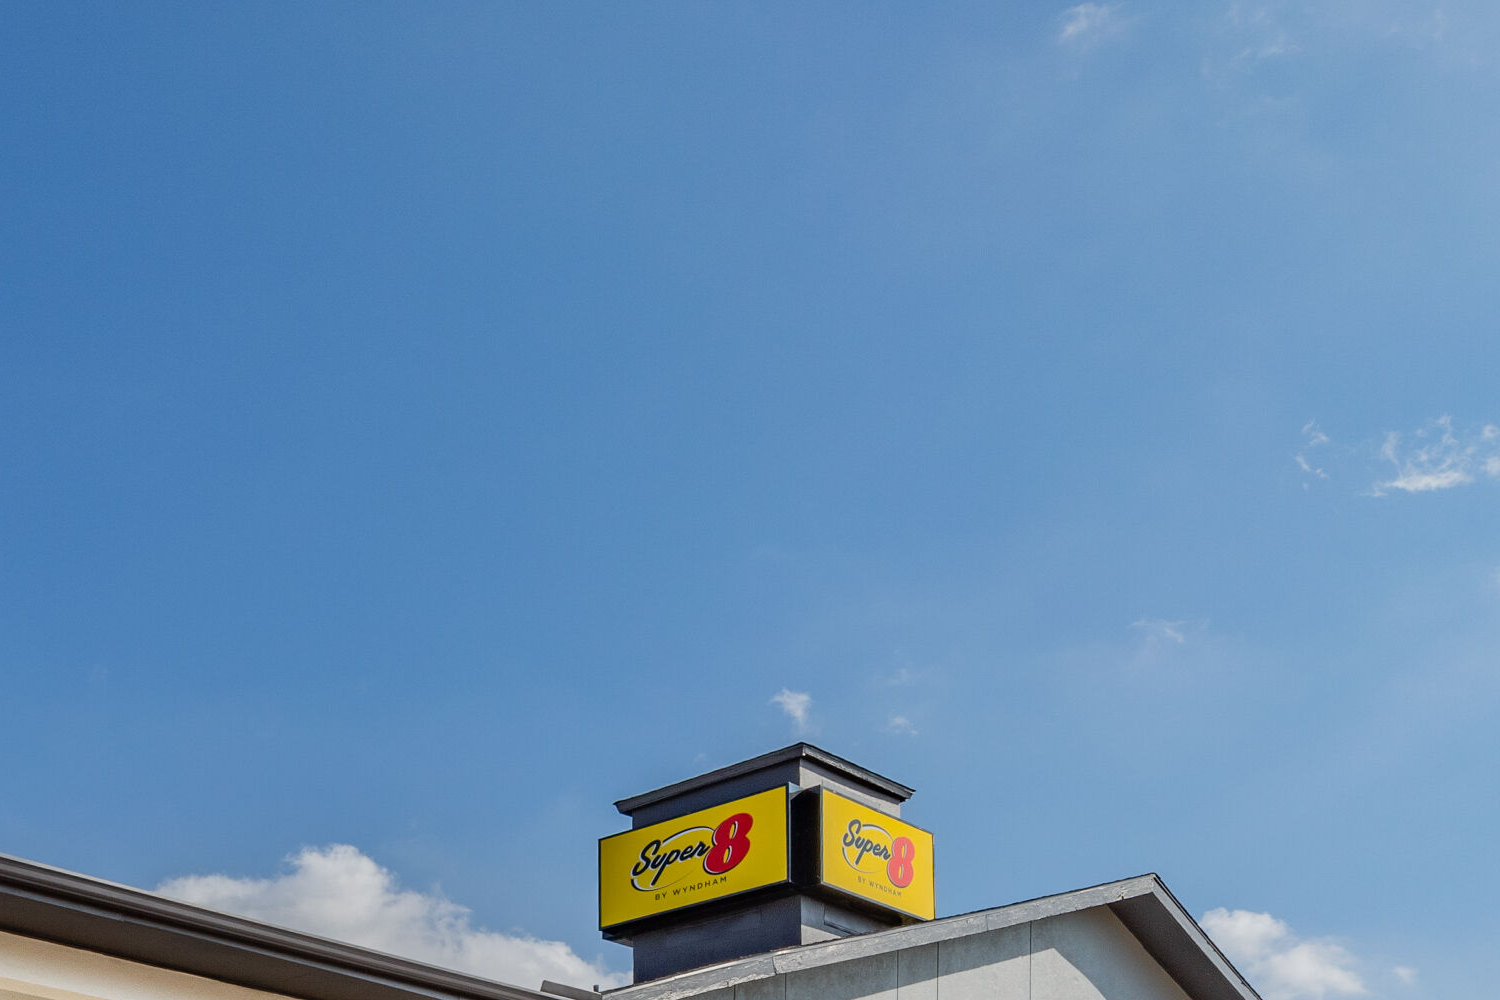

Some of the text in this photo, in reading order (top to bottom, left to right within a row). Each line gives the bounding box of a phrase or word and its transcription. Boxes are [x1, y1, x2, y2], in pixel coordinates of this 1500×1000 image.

[630, 812, 754, 887] Super 8
[842, 819, 916, 889] Super 8
[654, 876, 728, 901] BY WYNDHAM
[857, 875, 903, 897] BY WYNDHAM
